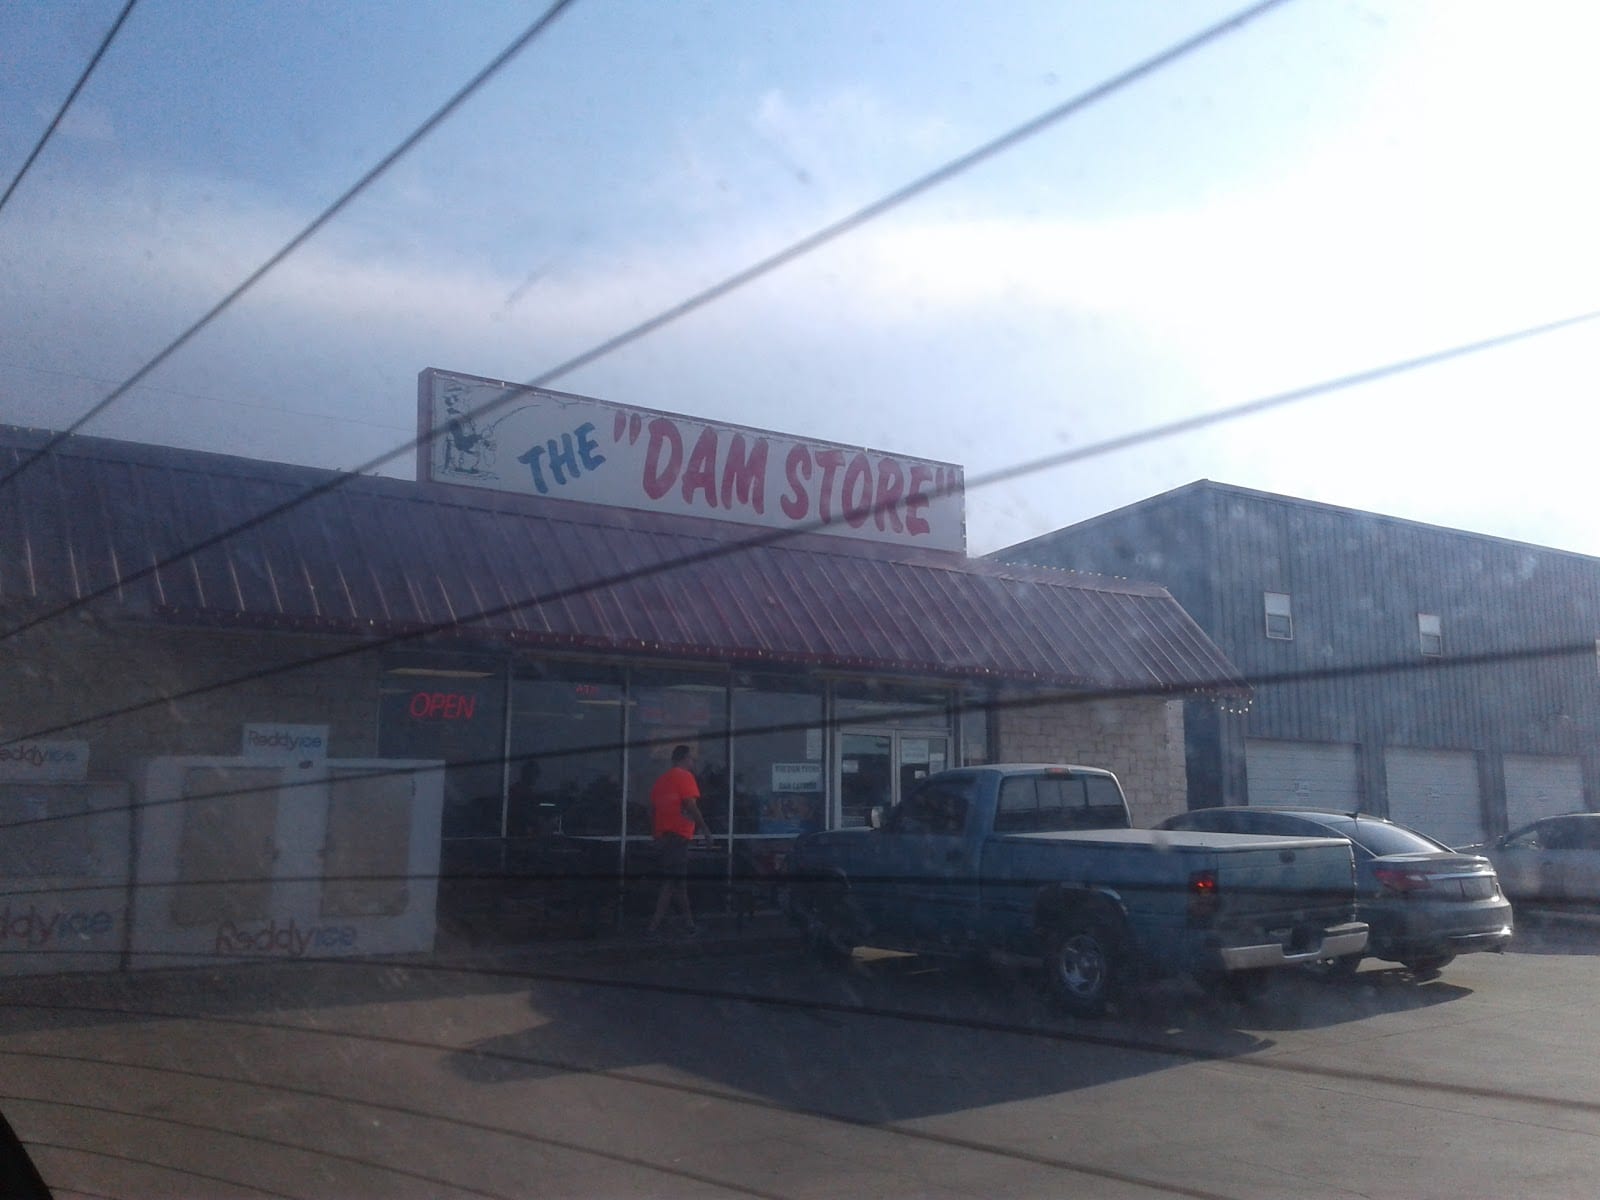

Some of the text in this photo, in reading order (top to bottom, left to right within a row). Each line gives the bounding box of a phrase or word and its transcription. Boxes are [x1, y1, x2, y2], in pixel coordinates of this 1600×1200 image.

[516, 421, 606, 495] THE
[613, 409, 768, 516] "DAM
[410, 692, 476, 720] OPEN
